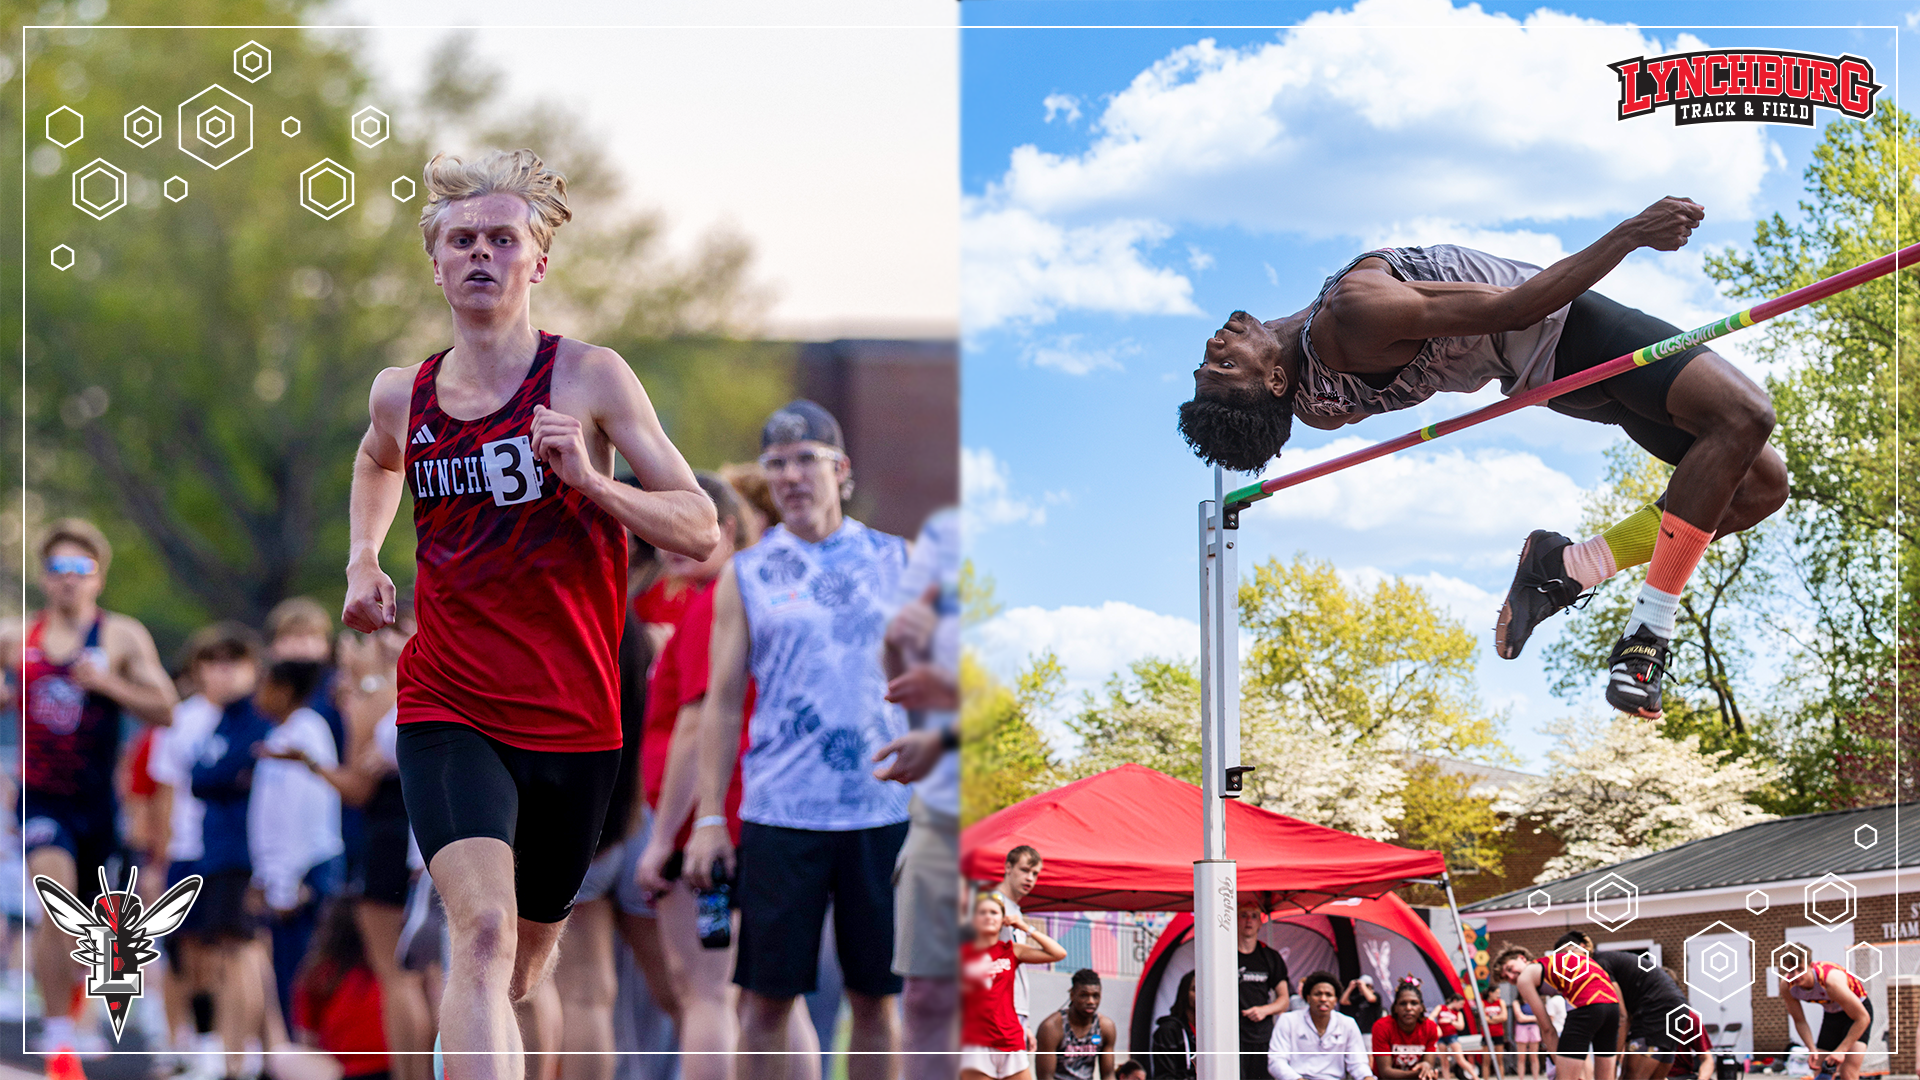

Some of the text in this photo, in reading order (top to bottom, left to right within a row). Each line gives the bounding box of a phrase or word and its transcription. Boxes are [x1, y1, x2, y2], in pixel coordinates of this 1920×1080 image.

[414, 452, 544, 499] LYNCH
[493, 442, 529, 502] 3
[1881, 920, 1919, 939] TEAM
